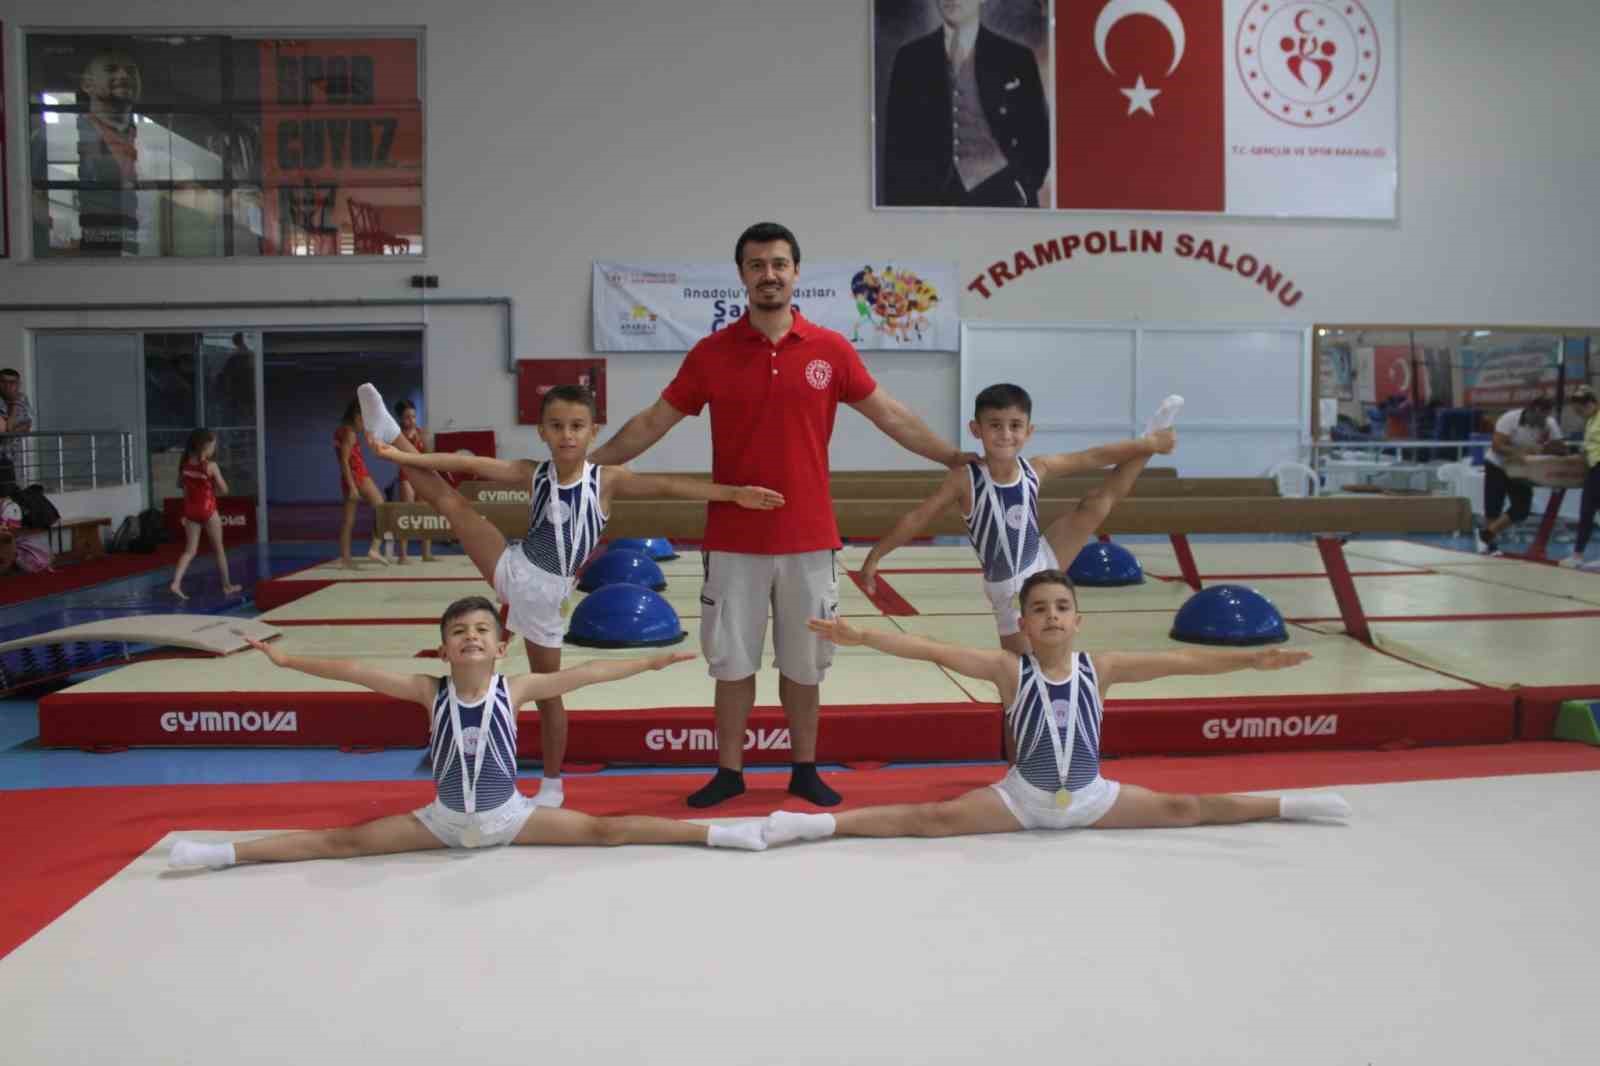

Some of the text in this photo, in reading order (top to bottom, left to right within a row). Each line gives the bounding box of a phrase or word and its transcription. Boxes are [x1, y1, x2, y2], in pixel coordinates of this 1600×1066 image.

[1174, 233, 1303, 307] SALONU
[793, 286, 836, 298] dızları
[478, 490, 530, 502] GYMNO
[397, 515, 450, 529] GYMN
[160, 711, 297, 732] GYMNOVA
[1202, 714, 1338, 739] GYMNOVA
[645, 728, 792, 751] GYMOVA
